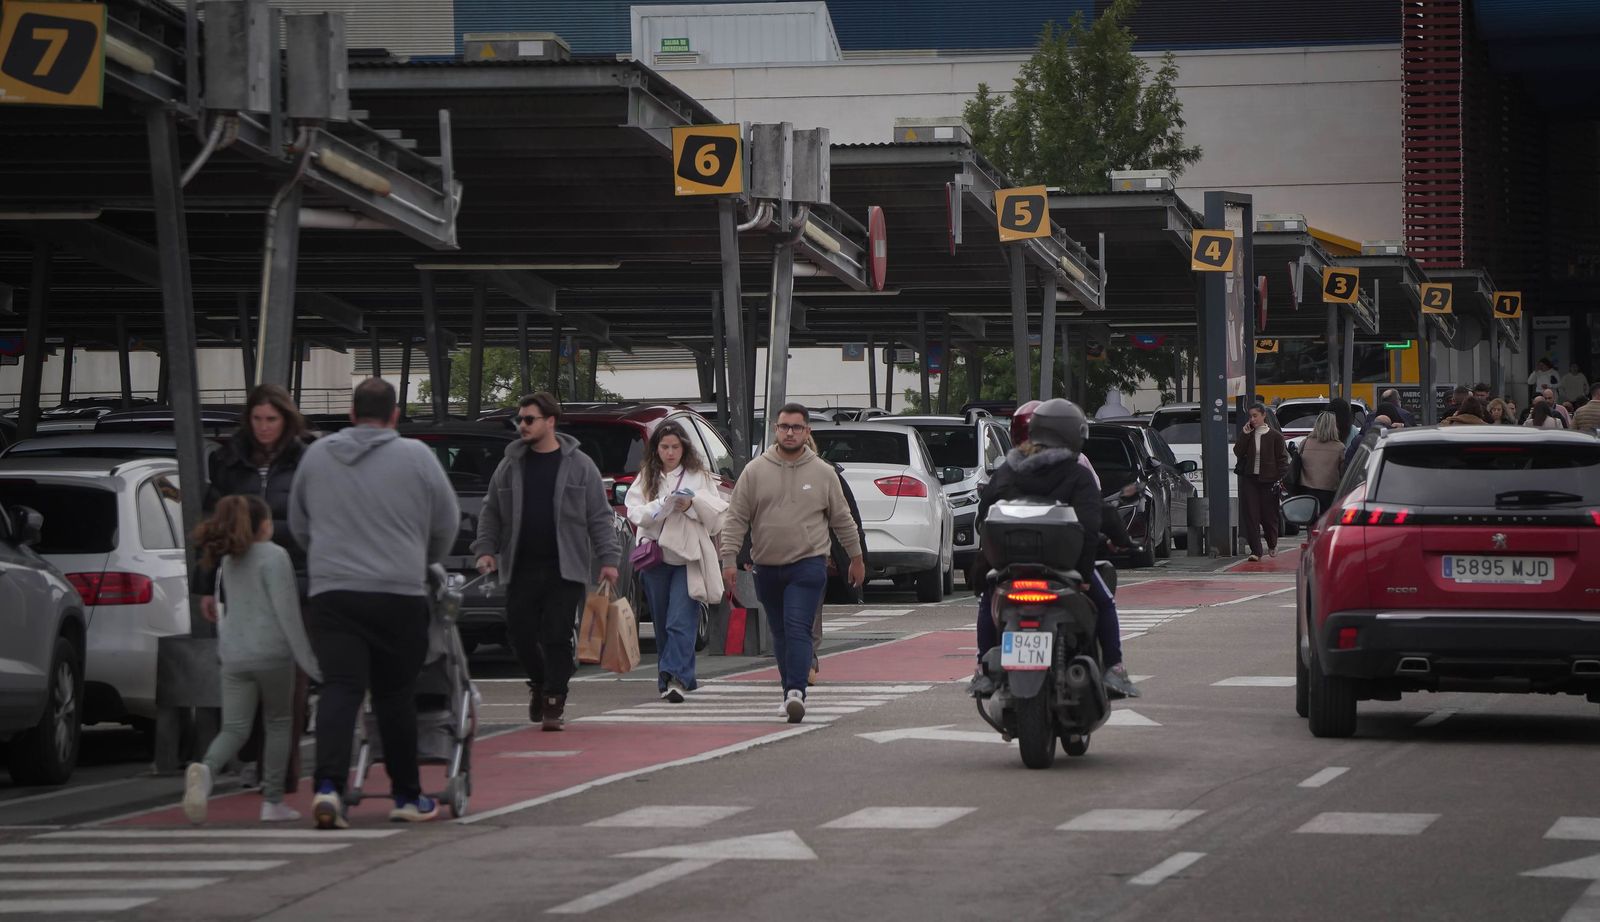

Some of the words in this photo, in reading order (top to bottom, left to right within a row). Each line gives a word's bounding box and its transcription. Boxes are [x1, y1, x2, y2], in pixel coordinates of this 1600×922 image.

[32, 28, 69, 76] 7
[694, 143, 720, 177] 6
[1013, 200, 1032, 226] 5
[1203, 240, 1221, 261] 4
[1335, 277, 1347, 294] 3
[1431, 291, 1442, 306] 2
[1503, 298, 1511, 312] 1
[1456, 559, 1505, 576] 5895
[1512, 560, 1549, 577] MJD
[1015, 635, 1048, 649] 9491
[1018, 650, 1044, 664] LTN
